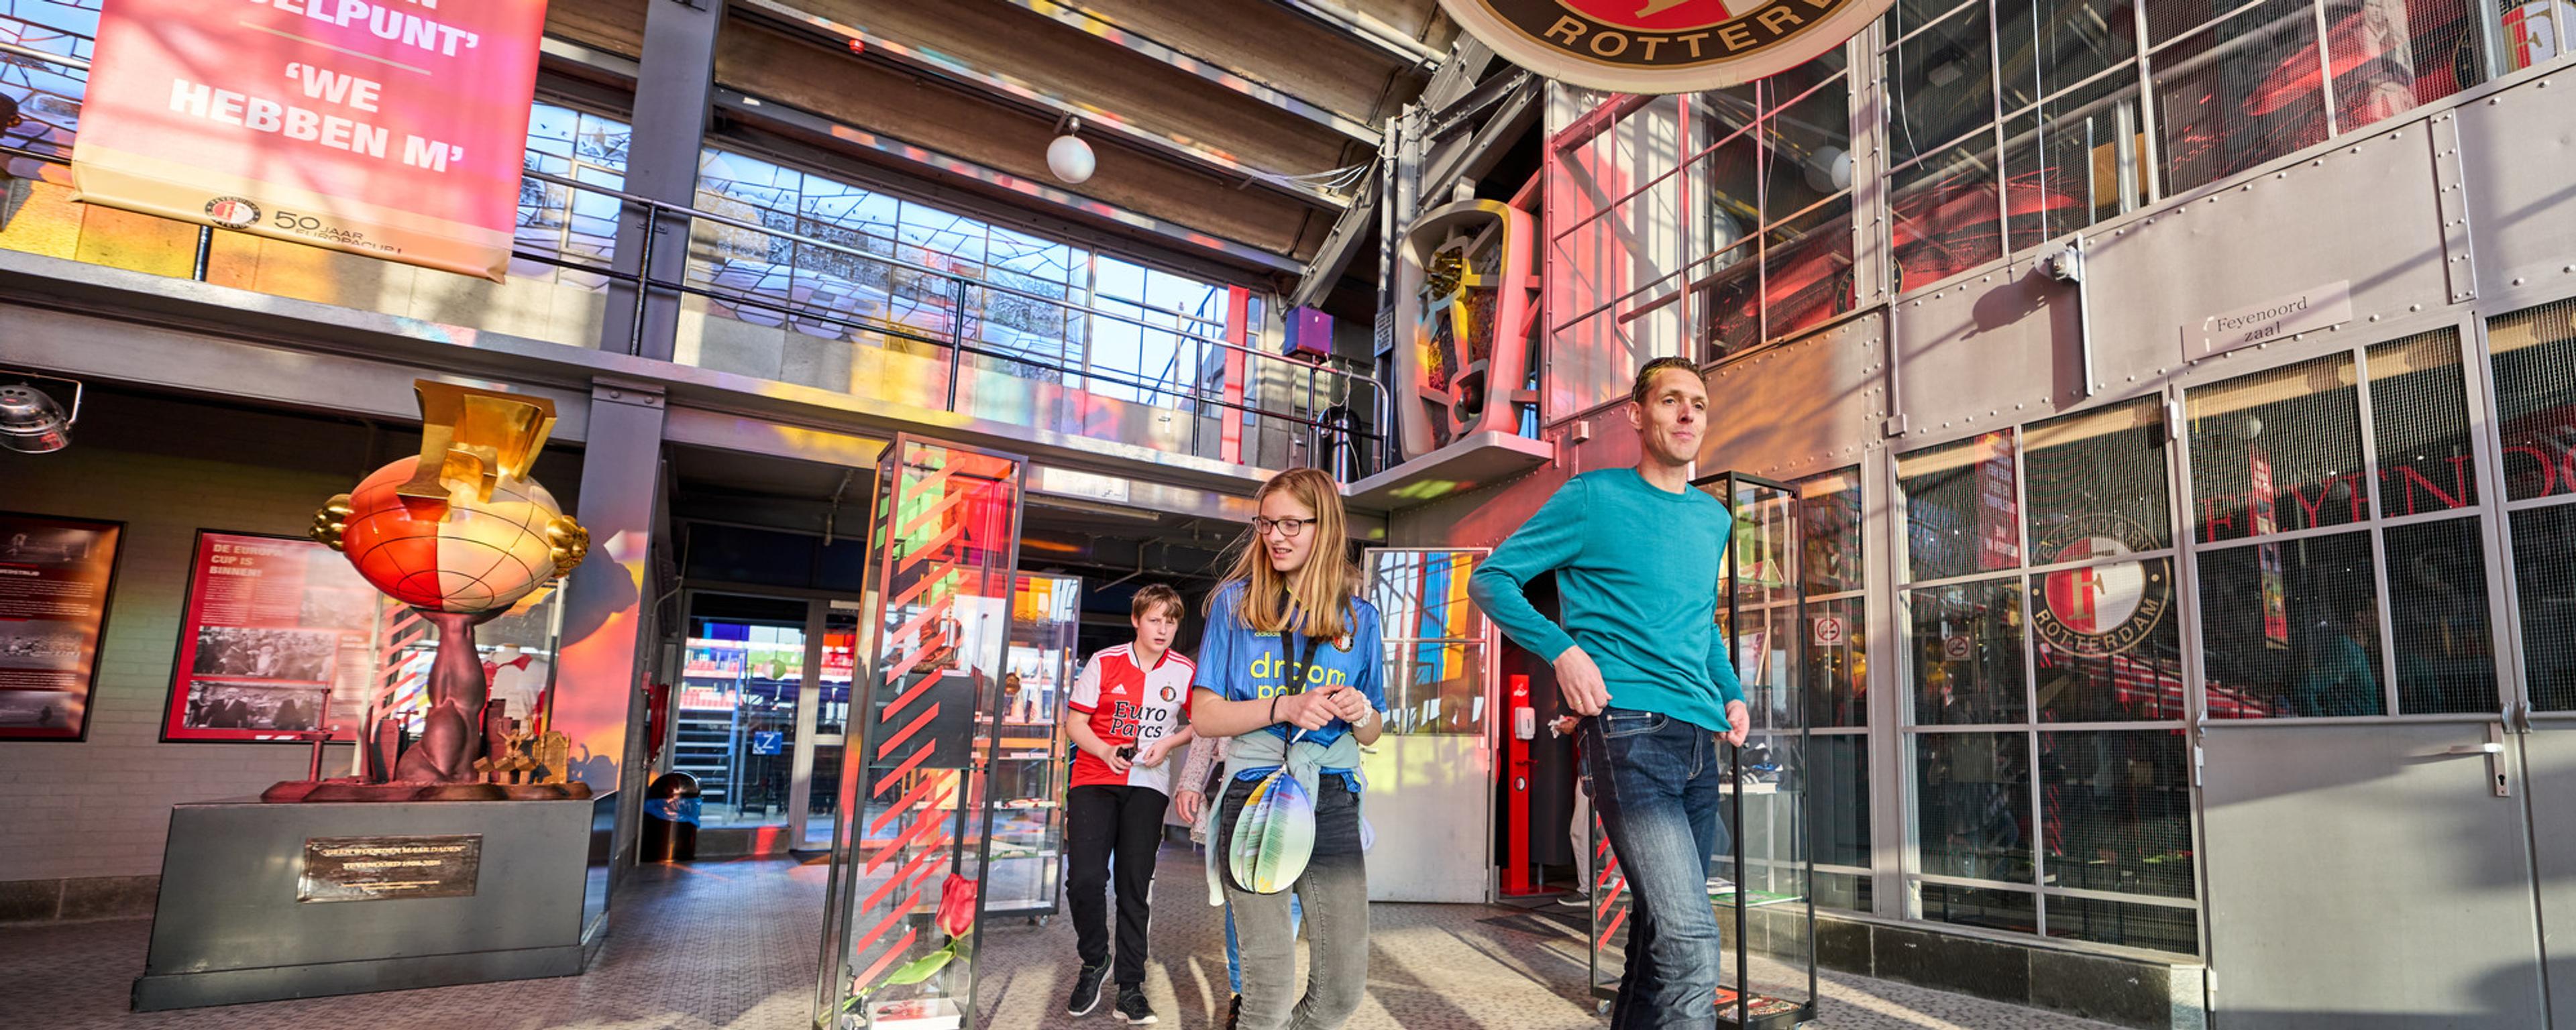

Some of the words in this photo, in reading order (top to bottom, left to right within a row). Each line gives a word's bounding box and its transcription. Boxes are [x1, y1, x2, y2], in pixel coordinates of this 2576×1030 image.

[250, 0, 479, 57] LPUNT’
[169, 78, 389, 159] HEBBEN
[274, 210, 321, 230] 50
[320, 227, 364, 240] JAAR
[2217, 296, 2308, 332] Feyenoord
[2244, 321, 2281, 343] zaal
[2195, 444, 2576, 544] FEYENO
[211, 555, 236, 564] CUP
[239, 557, 254, 566] IS
[212, 544, 231, 553] DE
[209, 566, 263, 577] BINNEN!
[2035, 597, 2159, 650] ROTTERDAM
[1114, 701, 1167, 722] Euro
[1110, 718, 1163, 738] Parcs
